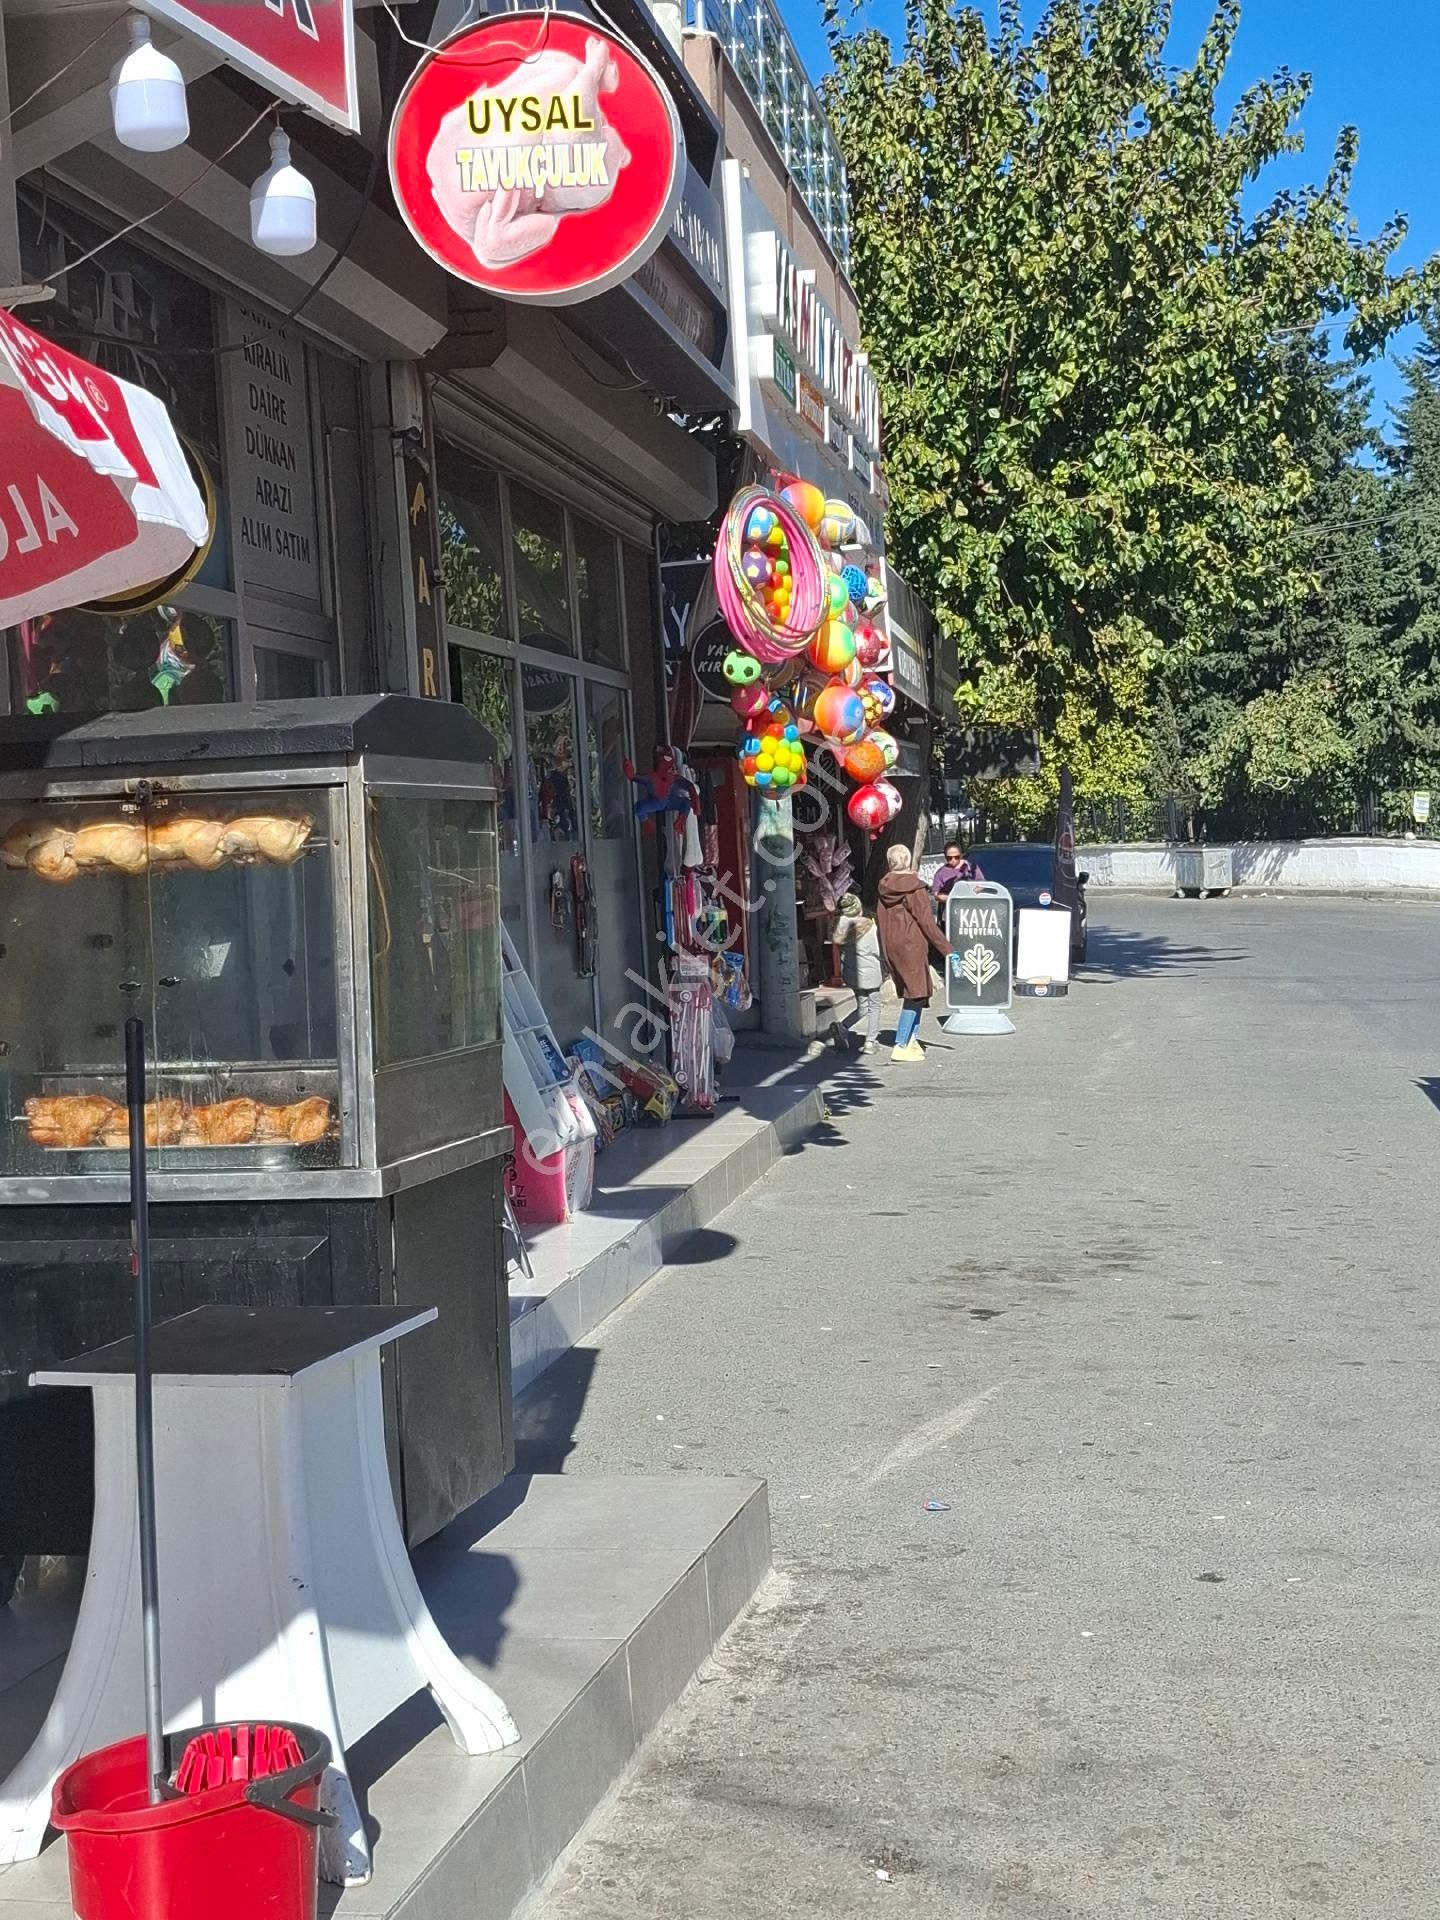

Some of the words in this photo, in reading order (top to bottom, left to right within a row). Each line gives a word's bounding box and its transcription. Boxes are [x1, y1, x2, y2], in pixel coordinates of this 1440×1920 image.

[467, 94, 593, 135] UYSAL
[456, 143, 609, 198] TAVUKÇULUK
[243, 333, 292, 385] KİRALIK
[249, 383, 288, 426] DAİRE
[245, 424, 297, 472] DÜKKAN
[255, 476, 293, 515] ARAZİ
[241, 516, 273, 553] ALIM
[275, 527, 312, 564] SATIM
[959, 908, 998, 929] KAYA
